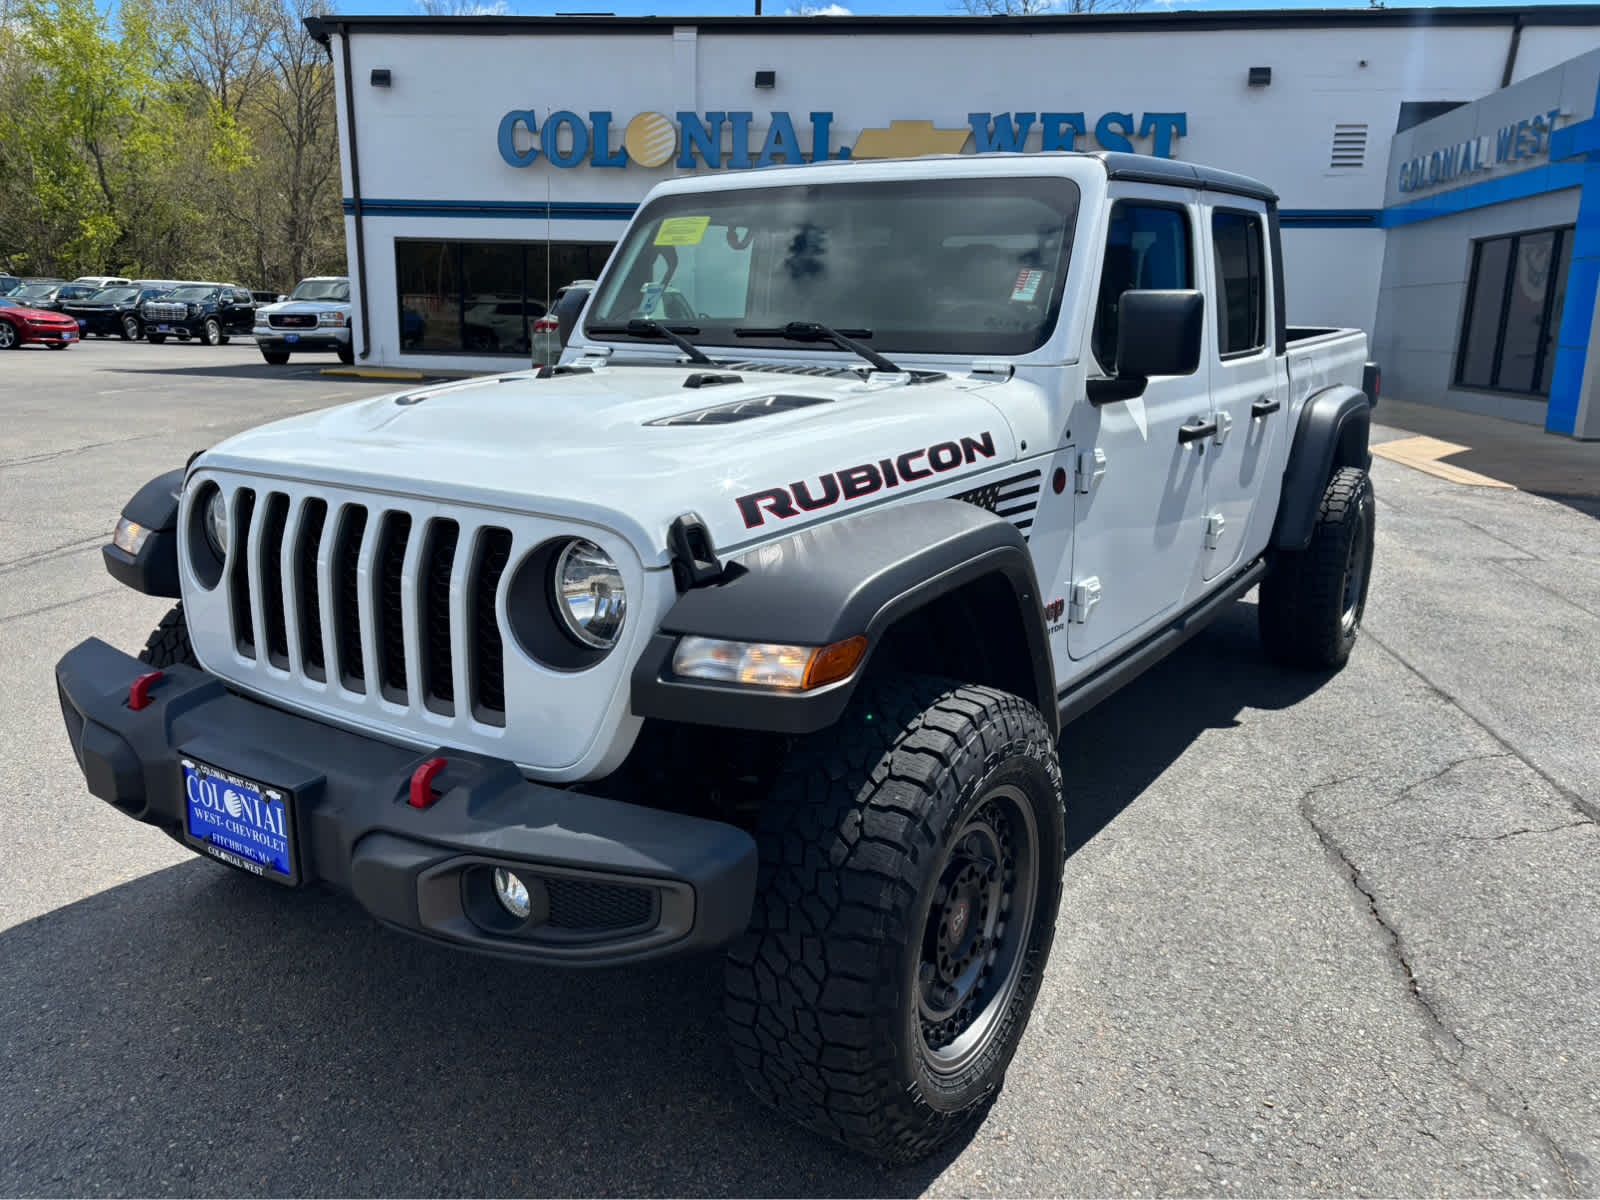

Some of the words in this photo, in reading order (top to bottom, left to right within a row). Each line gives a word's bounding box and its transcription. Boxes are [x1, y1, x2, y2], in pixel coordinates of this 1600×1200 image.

[497, 109, 851, 168] COLONIAL
[968, 112, 1187, 159] WEST
[1398, 136, 1488, 193] COLONIAL
[1495, 108, 1562, 166] WEST
[735, 431, 996, 529] RUBICON
[186, 774, 287, 838] COLONIAL
[226, 819, 286, 853] CHEVROLET
[244, 861, 263, 876] WEST
